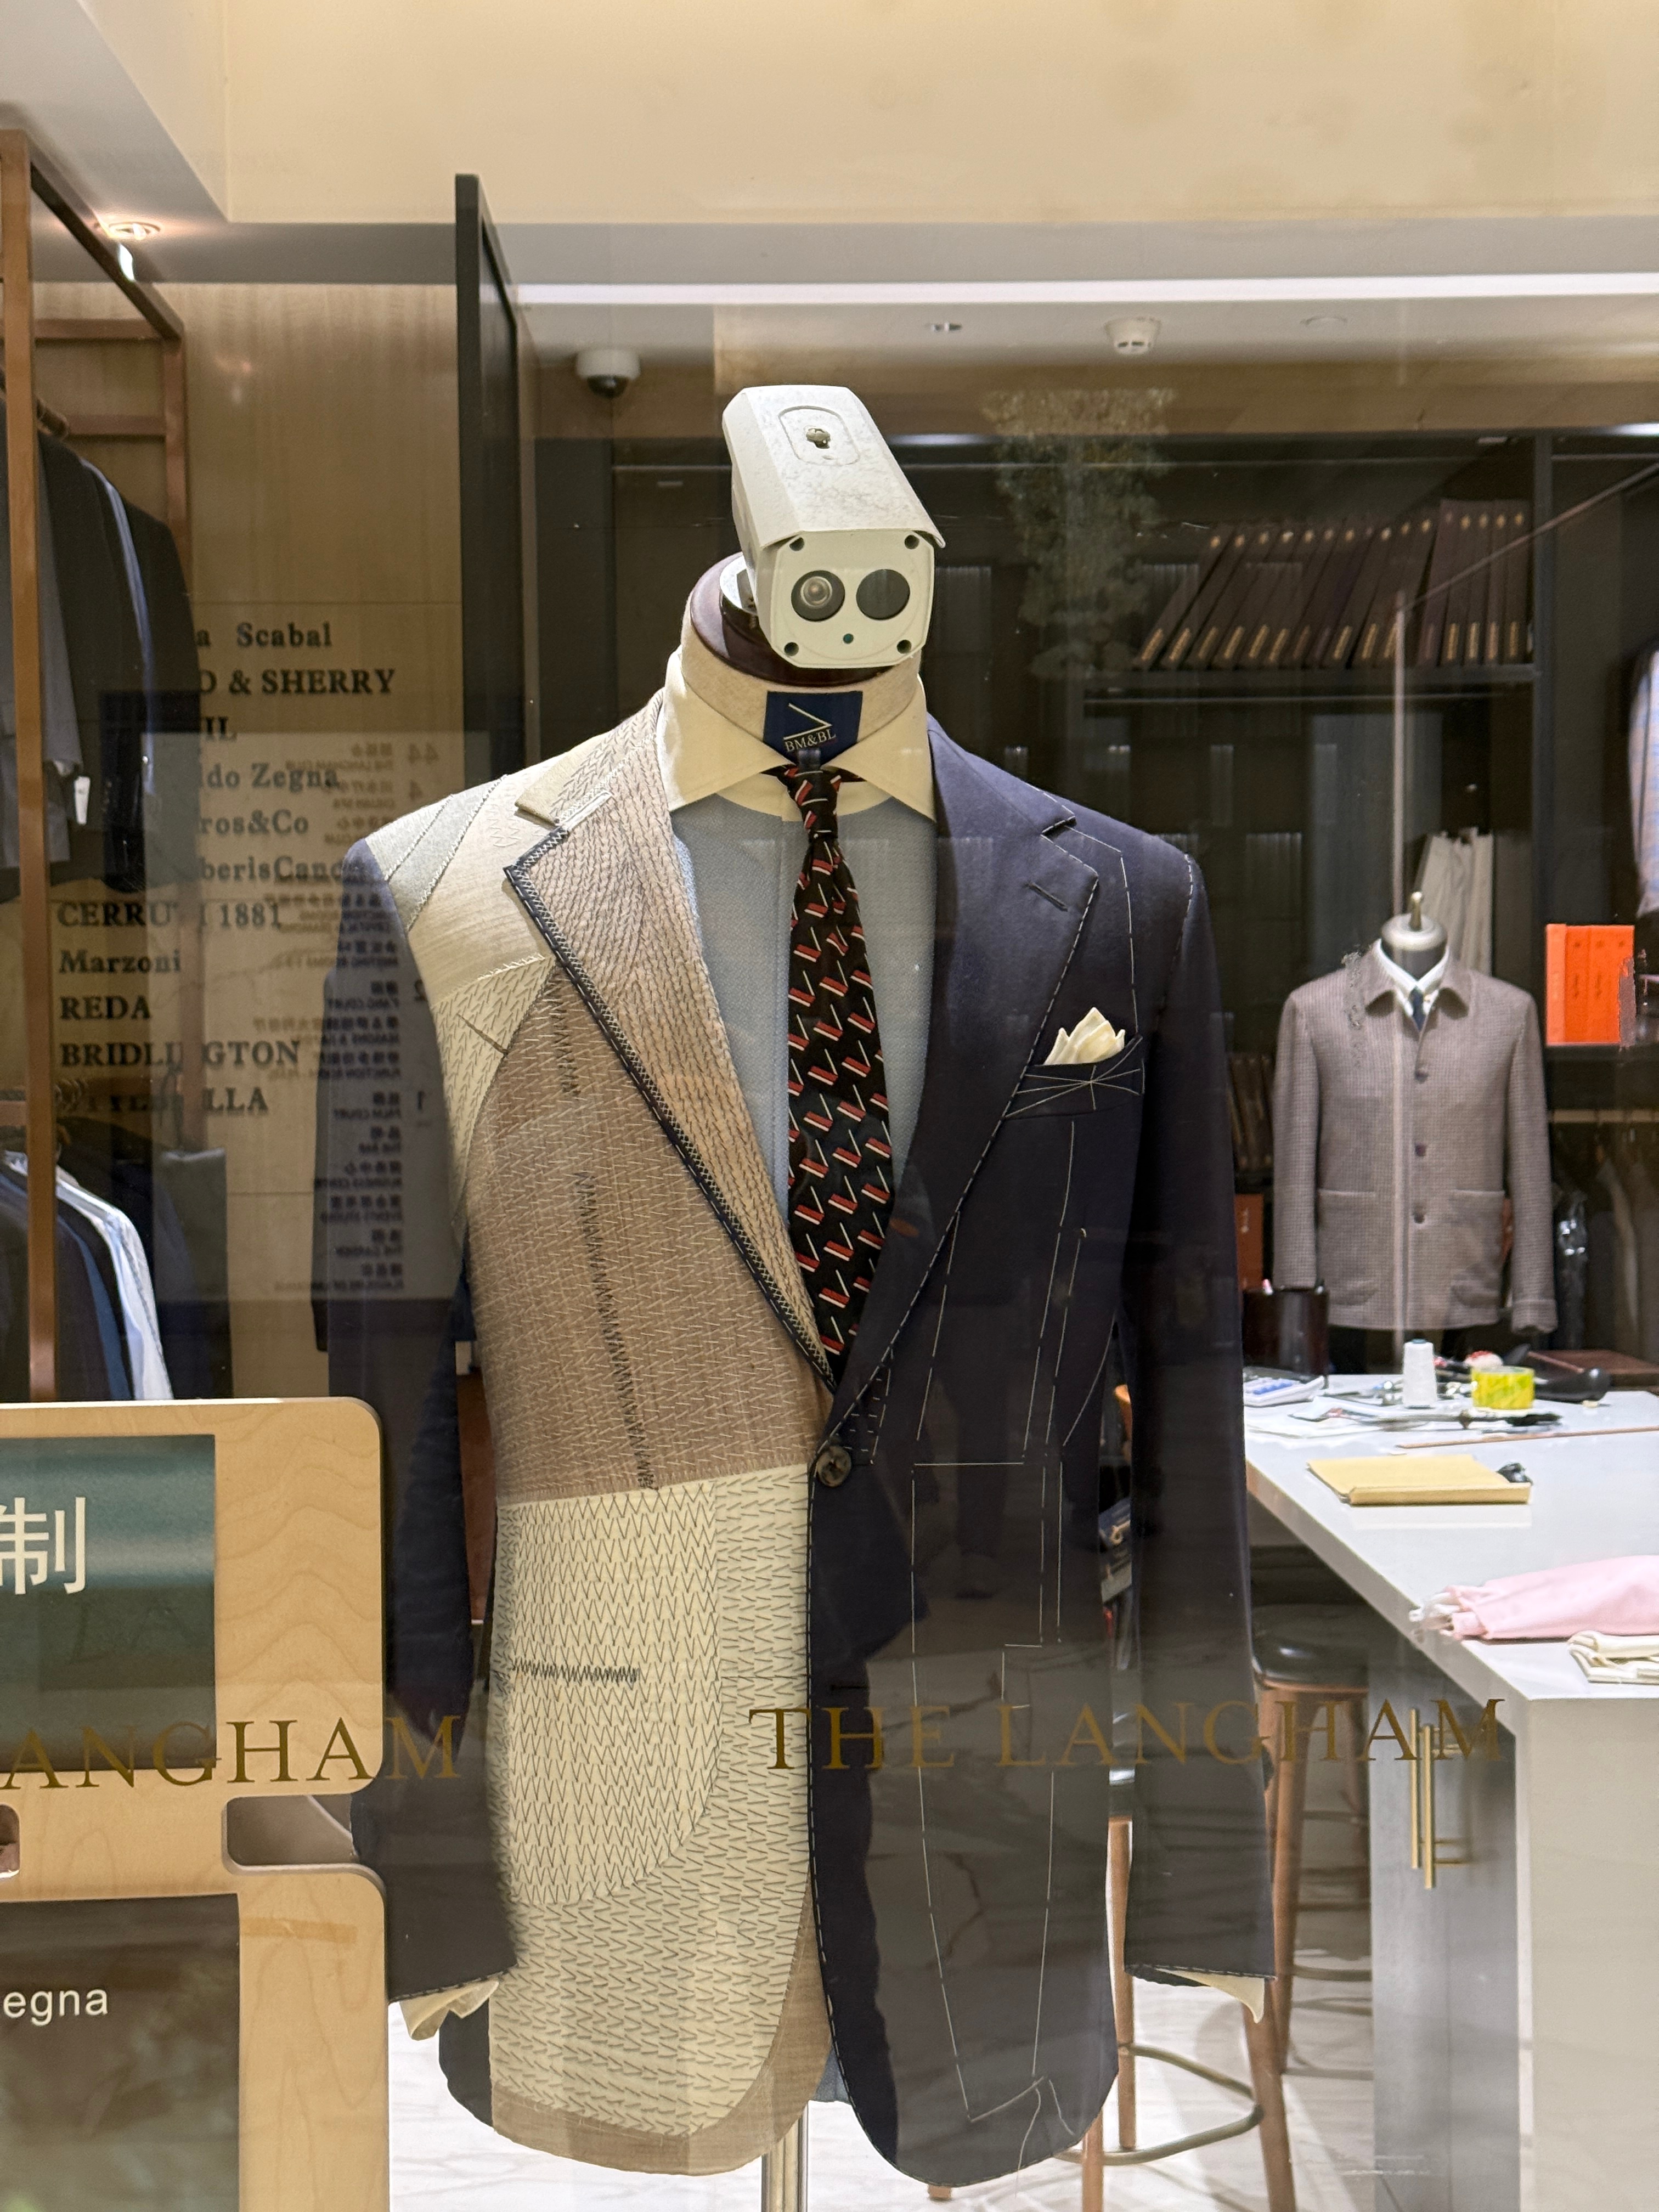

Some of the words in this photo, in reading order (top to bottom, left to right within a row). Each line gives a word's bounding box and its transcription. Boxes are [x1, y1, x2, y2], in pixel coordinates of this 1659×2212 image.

[236, 622, 332, 647] Scabal
[228, 669, 251, 695] &
[261, 669, 395, 695] SHERRY
[785, 729, 837, 753] BM&BL
[252, 763, 340, 792] Zegna
[221, 904, 281, 928] 1881
[59, 950, 181, 974] Marzoni
[60, 996, 151, 1020] REDA
[748, 1705, 955, 1770] THE
[996, 1699, 1505, 1767] LANGHAM
[0, 1715, 461, 1791] ANGHAM
[3, 1988, 108, 2026] egna
